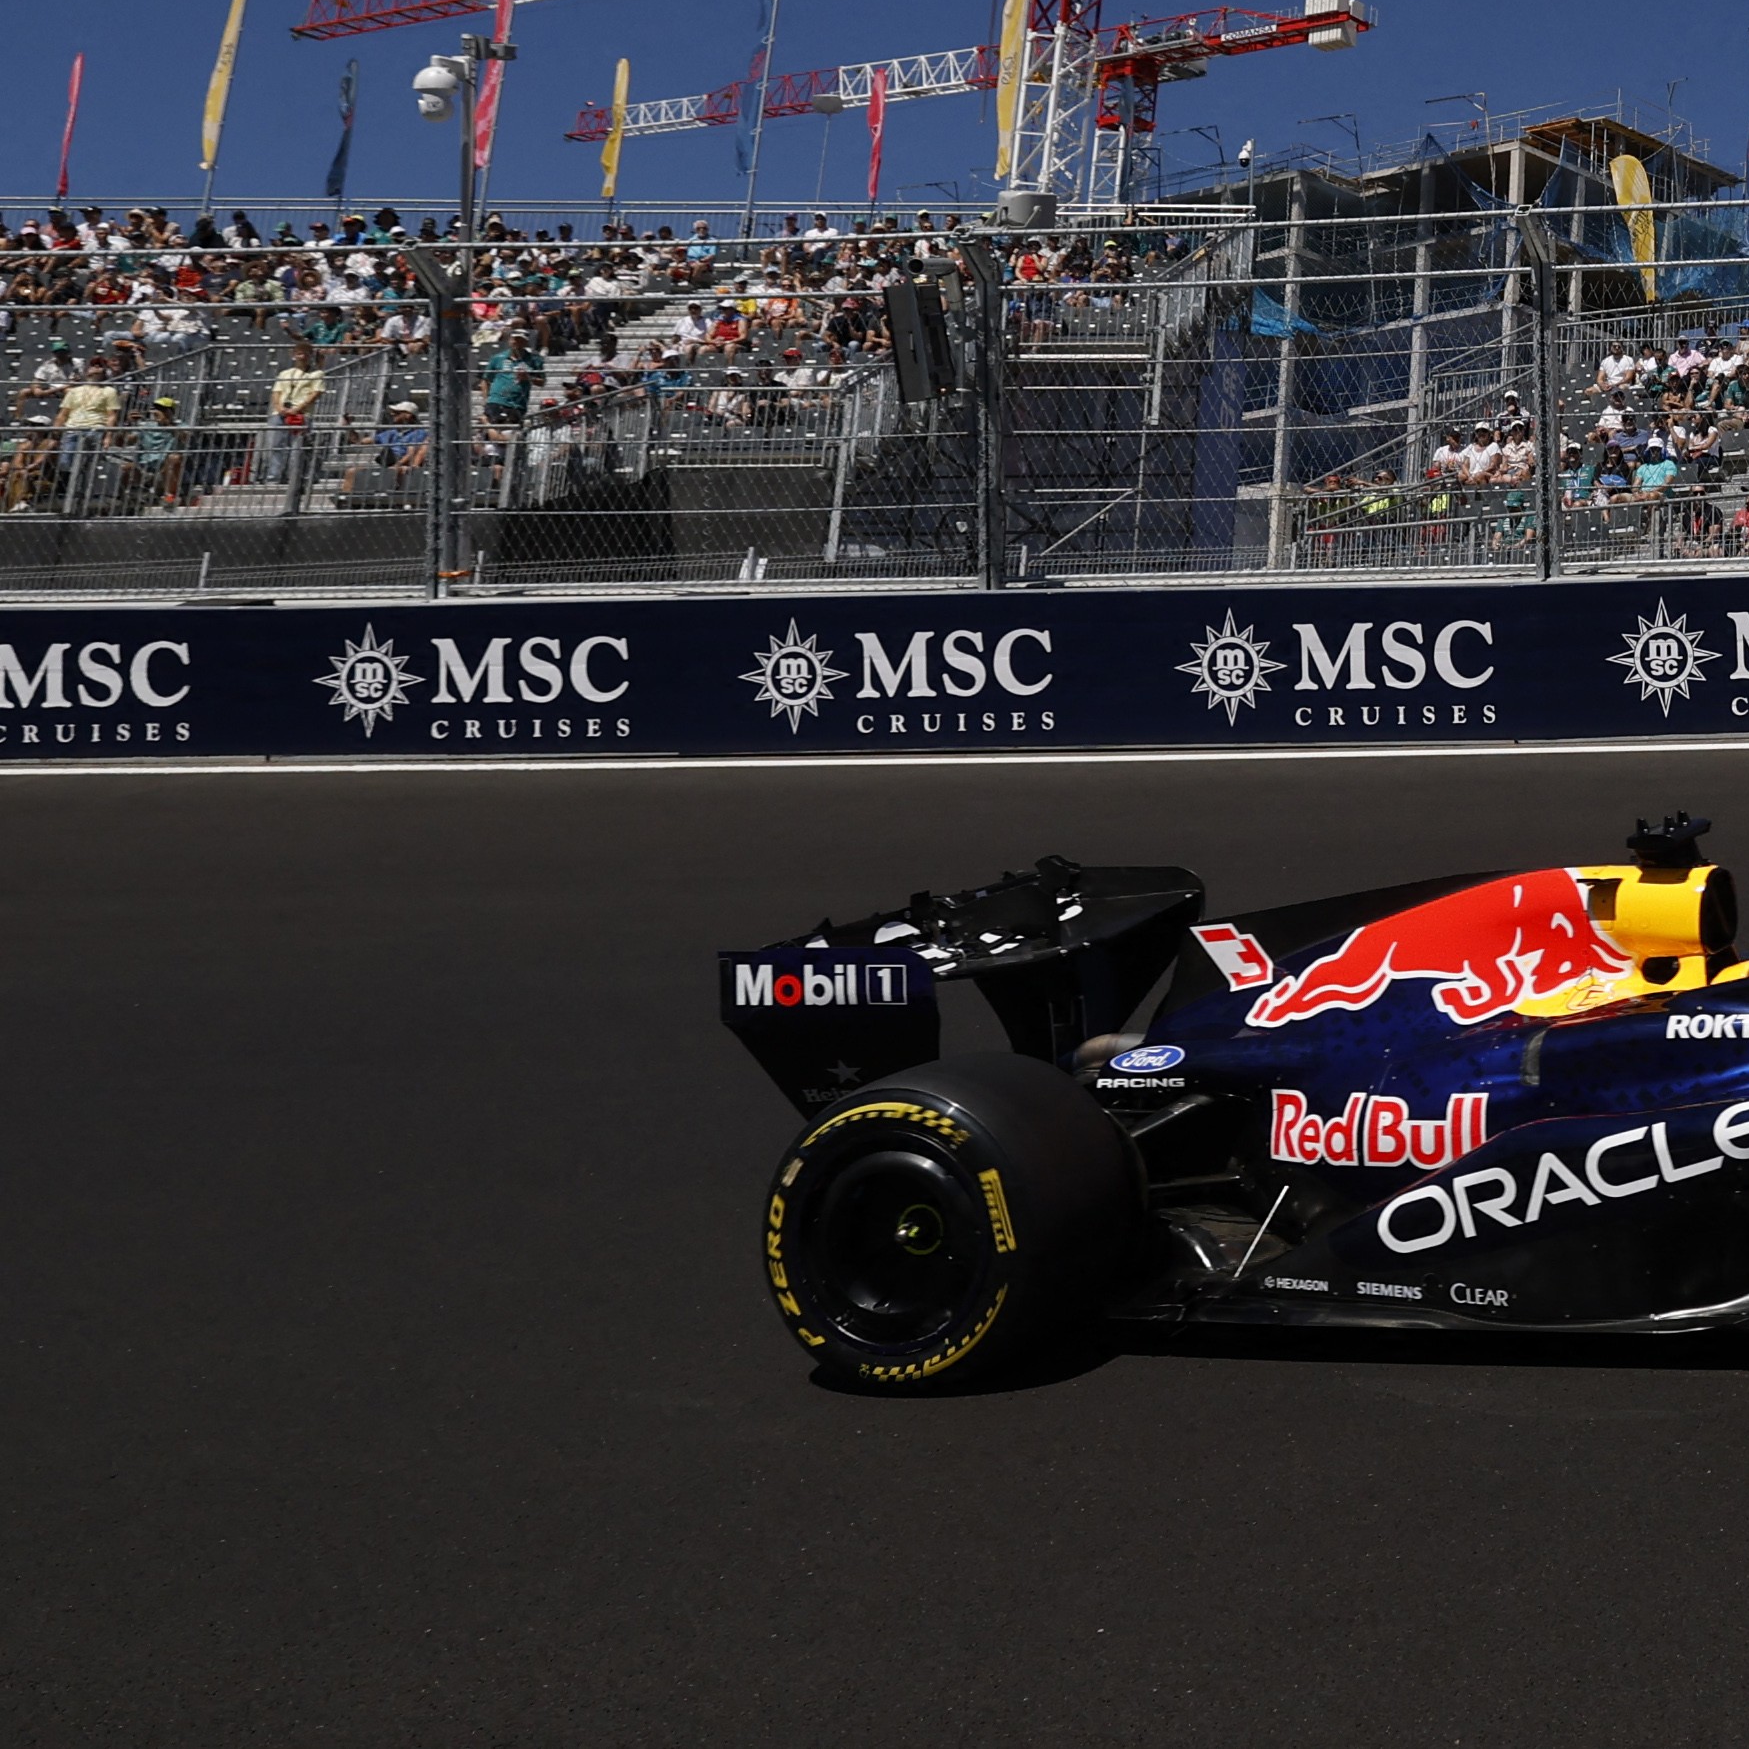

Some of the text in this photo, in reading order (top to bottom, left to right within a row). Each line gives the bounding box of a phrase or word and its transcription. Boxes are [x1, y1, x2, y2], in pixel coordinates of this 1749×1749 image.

[1224, 25, 1274, 41] COMANSA
[431, 636, 630, 703] MSC
[855, 629, 1053, 698] MSC
[1293, 620, 1494, 690] MSC
[0, 641, 190, 708] MSC
[431, 719, 630, 739] CRUISES
[857, 712, 1055, 733] CRUISES
[1295, 705, 1496, 726] CRUISES
[735, 964, 858, 1007] Mobil
[1121, 1050, 1172, 1068] Ford
[1096, 1077, 1186, 1089] RACING
[1271, 1089, 1489, 1170] Red Bull
[977, 1167, 1017, 1253] PIRELLI
[767, 1193, 826, 1347] P ZERO
[1276, 1277, 1329, 1292] HEXAGON
[1356, 1281, 1423, 1300] SIEMENS
